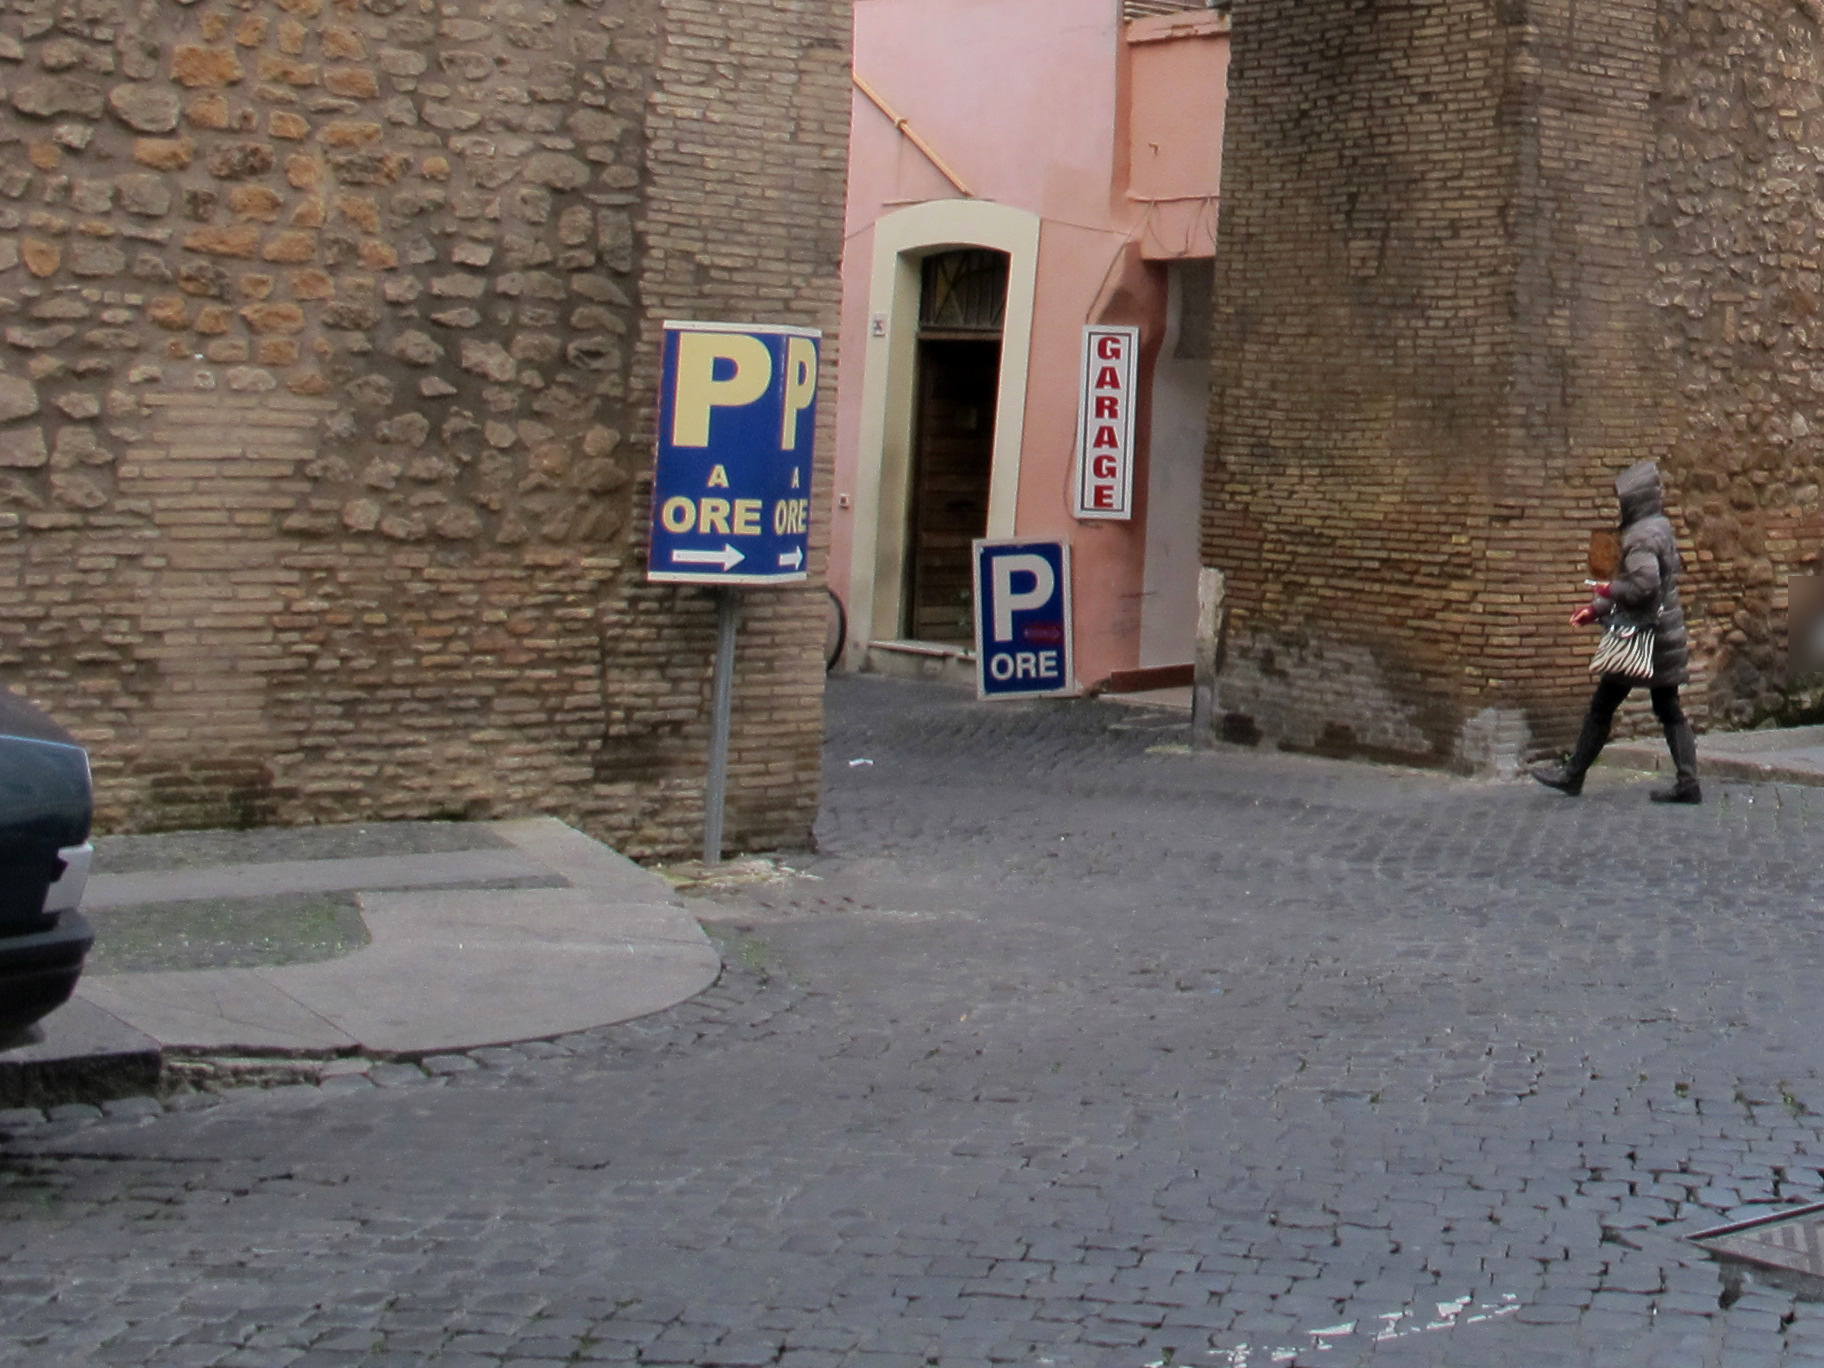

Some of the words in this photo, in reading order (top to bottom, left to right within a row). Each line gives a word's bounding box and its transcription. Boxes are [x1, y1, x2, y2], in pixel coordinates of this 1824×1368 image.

[672, 331, 773, 448] P
[781, 336, 817, 451] P
[1093, 336, 1122, 509] GARAGE
[706, 464, 730, 488] A
[791, 466, 800, 489] A
[661, 495, 763, 535] ORE
[774, 498, 808, 536] ORE
[992, 553, 1055, 642] P
[990, 650, 1059, 681] ORE
